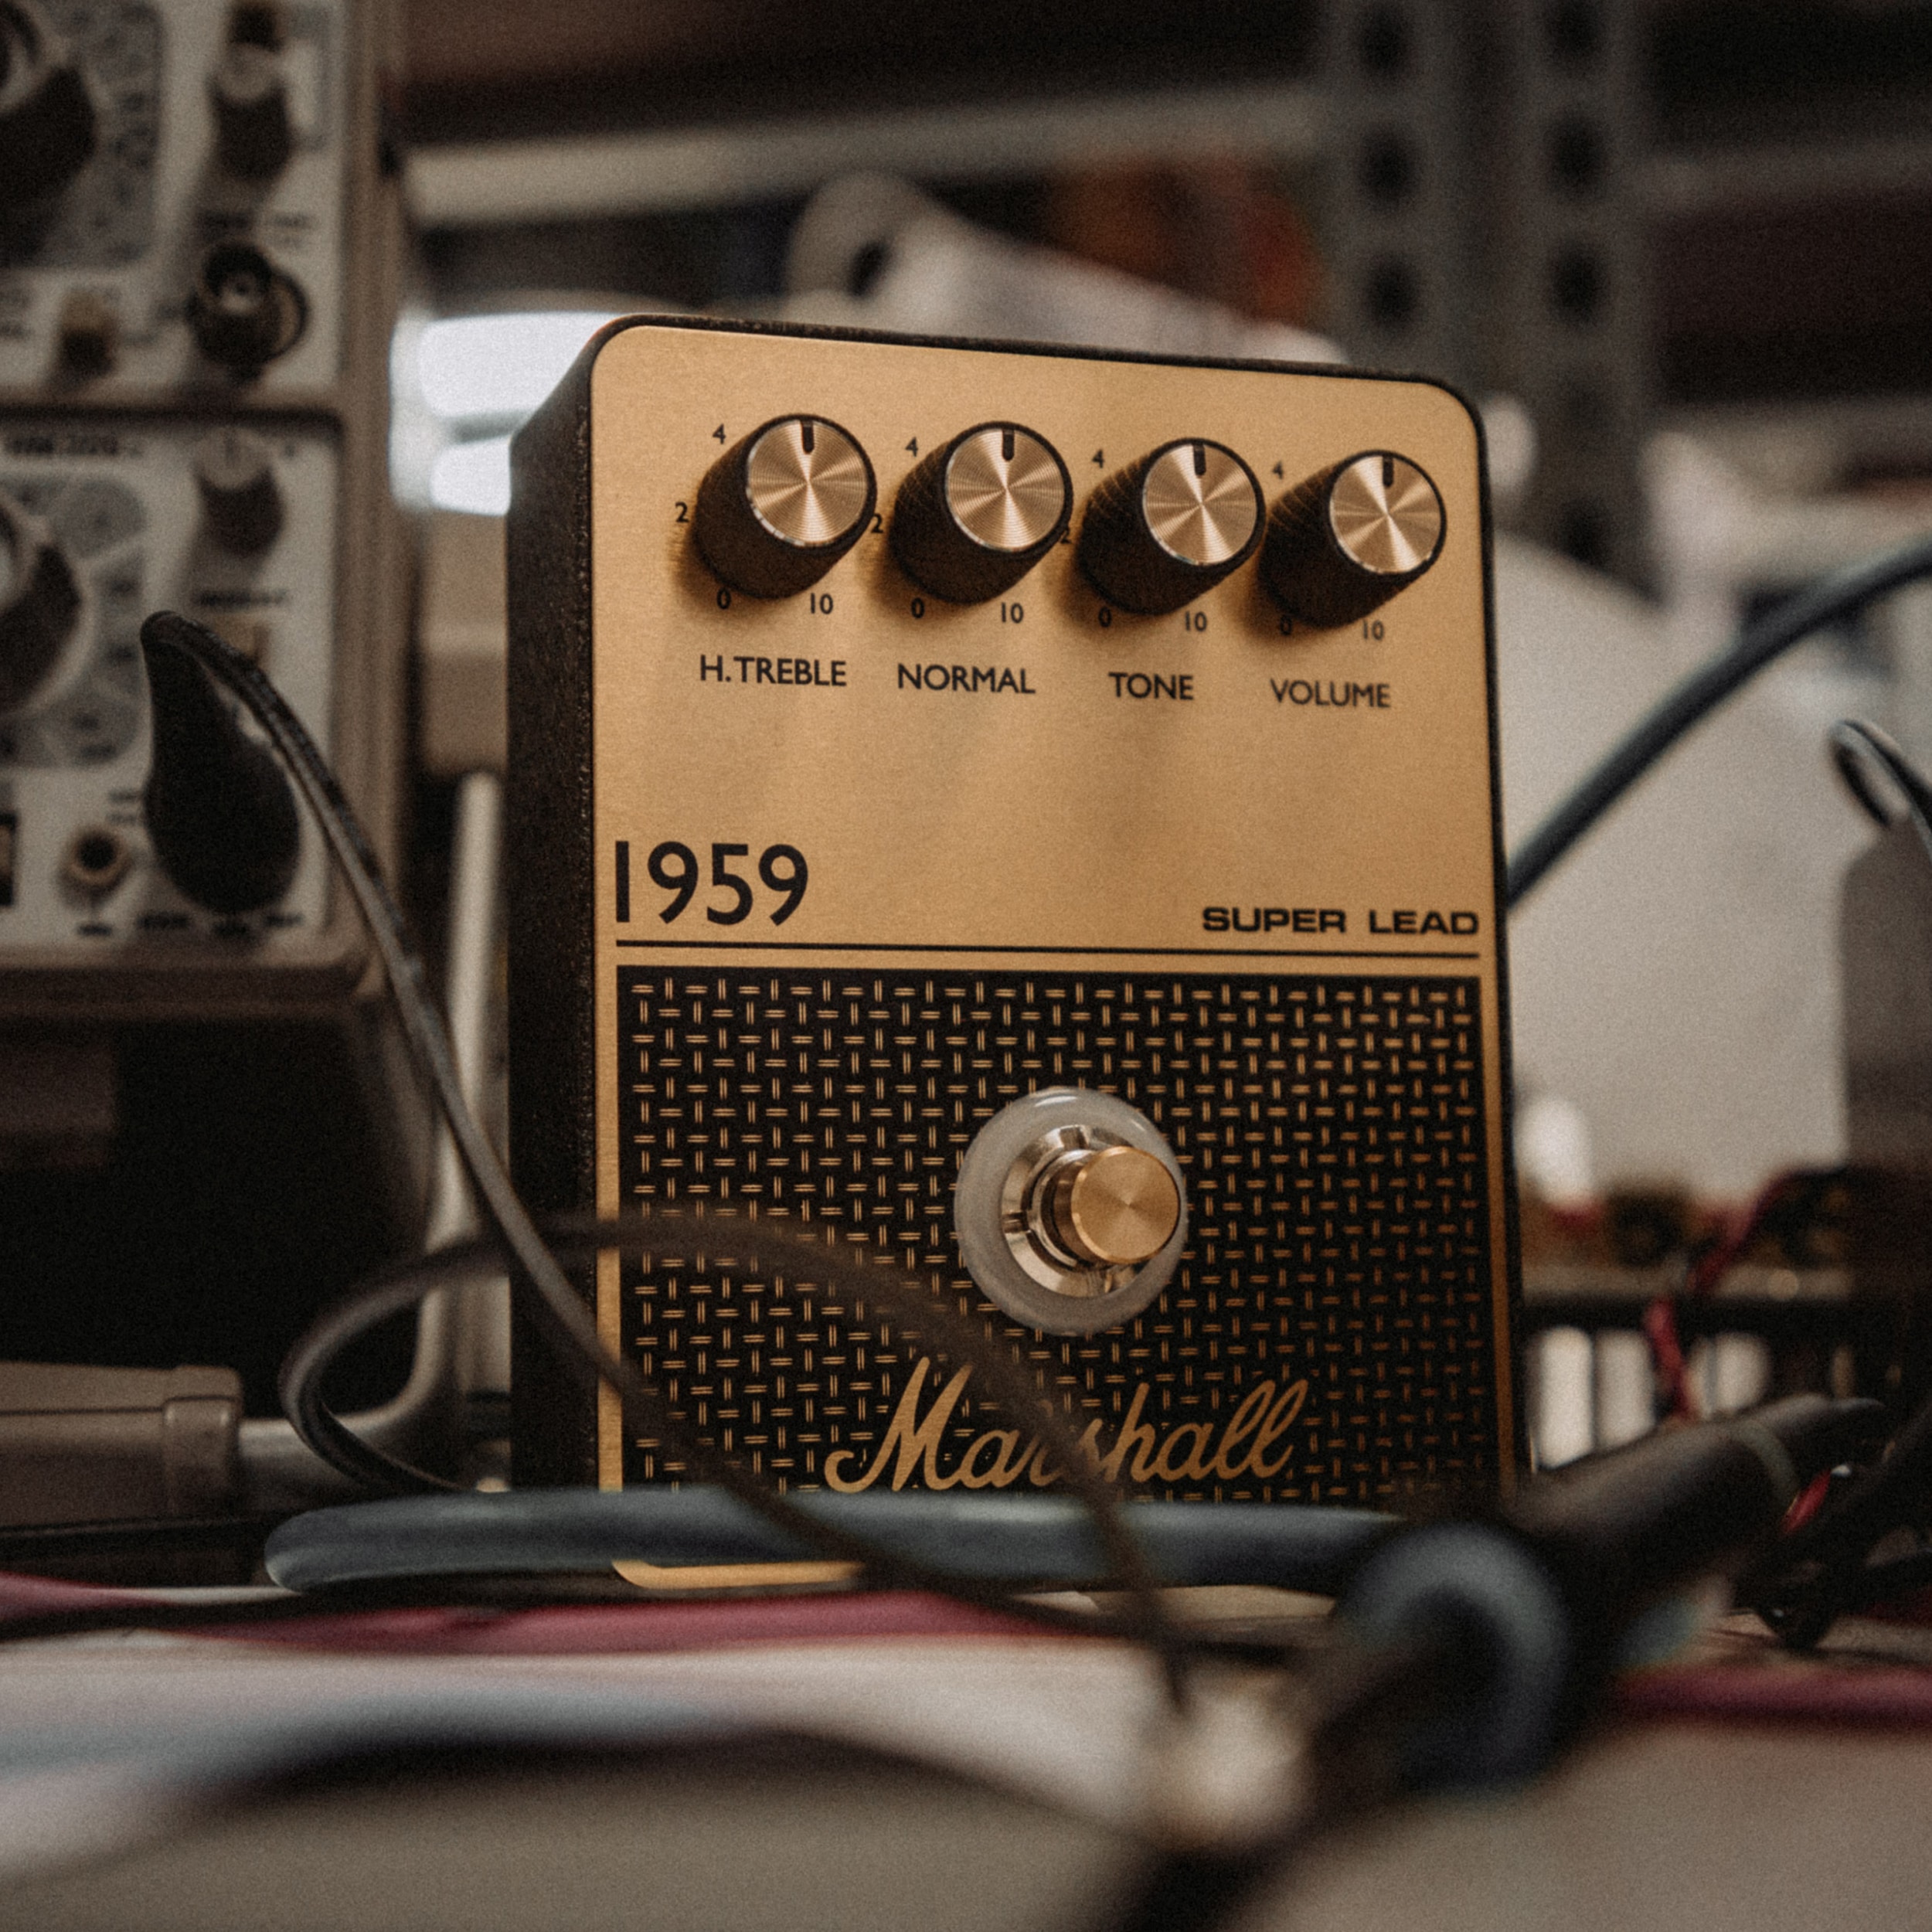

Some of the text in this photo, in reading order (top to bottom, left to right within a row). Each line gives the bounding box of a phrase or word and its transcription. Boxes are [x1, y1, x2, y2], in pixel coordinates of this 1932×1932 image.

[713, 424, 726, 444] 4
[904, 437, 919, 457] 4
[1092, 449, 1104, 468] 4
[1272, 461, 1284, 479] 4
[675, 502, 689, 522] 2
[869, 514, 883, 533] 2
[716, 589, 731, 609] 0
[809, 594, 834, 615] 10
[911, 598, 925, 619] 0
[1001, 603, 1024, 623] 10
[1098, 608, 1112, 628] 0
[1184, 611, 1207, 632] 10
[1362, 620, 1384, 640] 10
[699, 655, 847, 687] H.TREBLE
[897, 663, 1036, 694] NORMAL
[1108, 672, 1194, 700] TONE
[1270, 679, 1391, 708] VOLUME
[615, 840, 808, 926] 1959
[1202, 906, 1479, 935] SUPER LEAD
